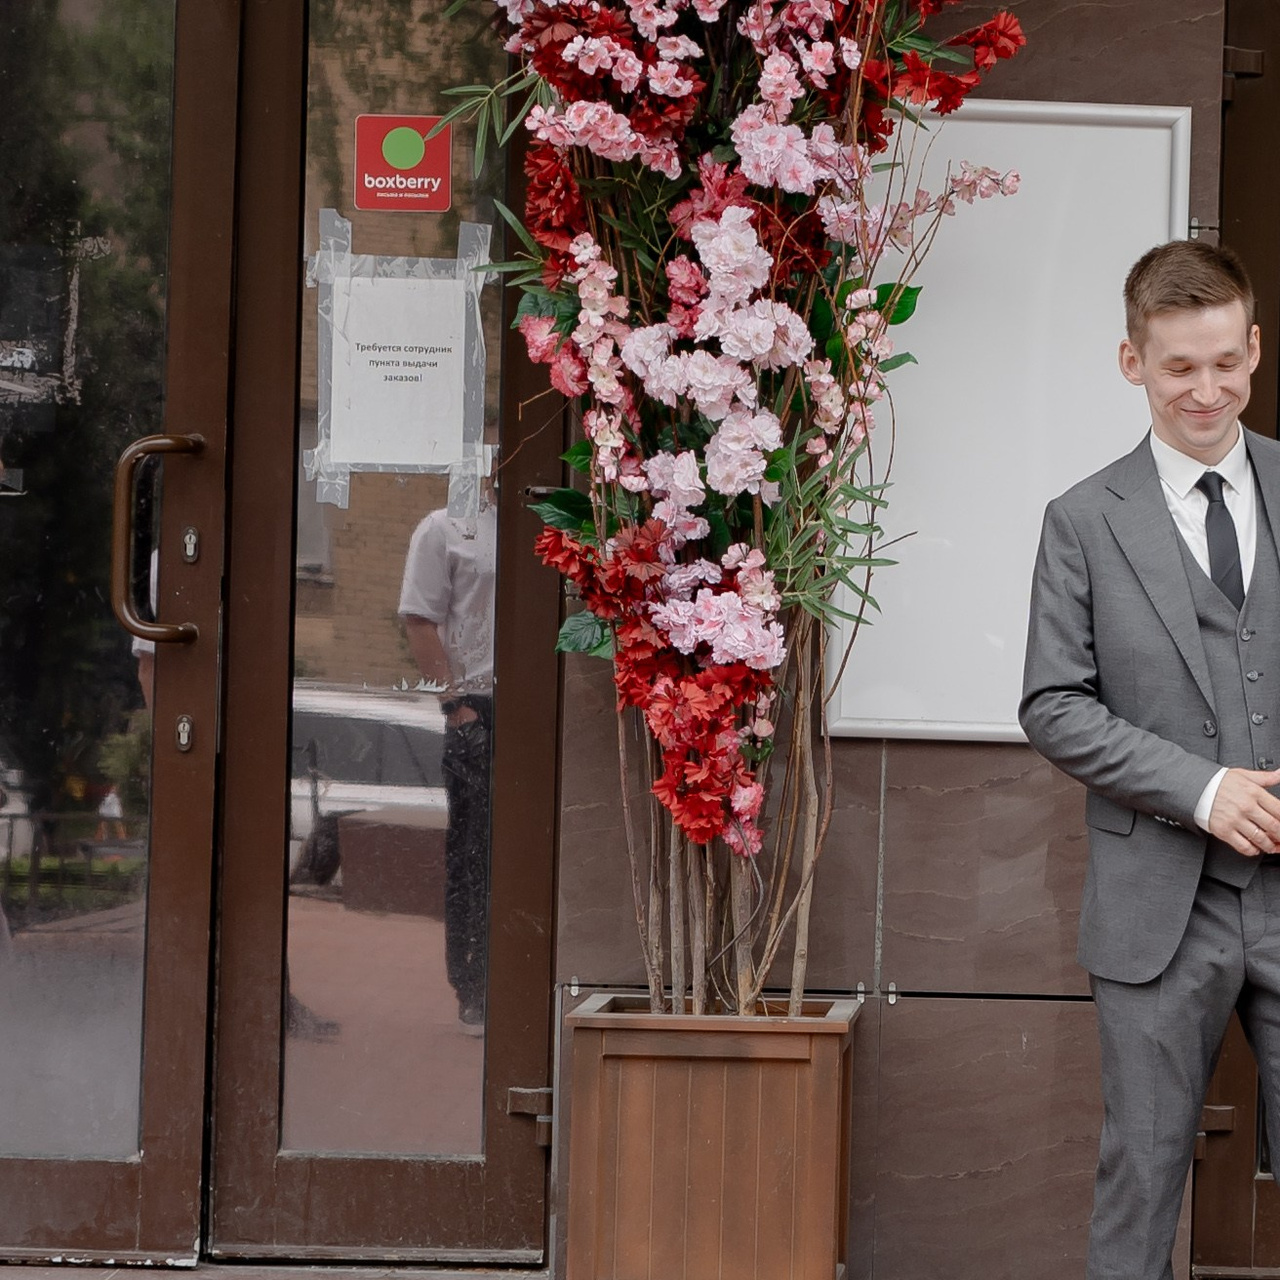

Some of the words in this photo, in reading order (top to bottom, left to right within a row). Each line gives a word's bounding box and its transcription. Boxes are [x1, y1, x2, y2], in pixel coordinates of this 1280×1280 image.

[364, 173, 442, 192] boxberry
[355, 342, 401, 352] Требуется
[404, 344, 453, 354] сотрудник
[369, 359, 400, 368] пункта
[402, 360, 438, 368] выдачи
[383, 374, 423, 382] заказов!
